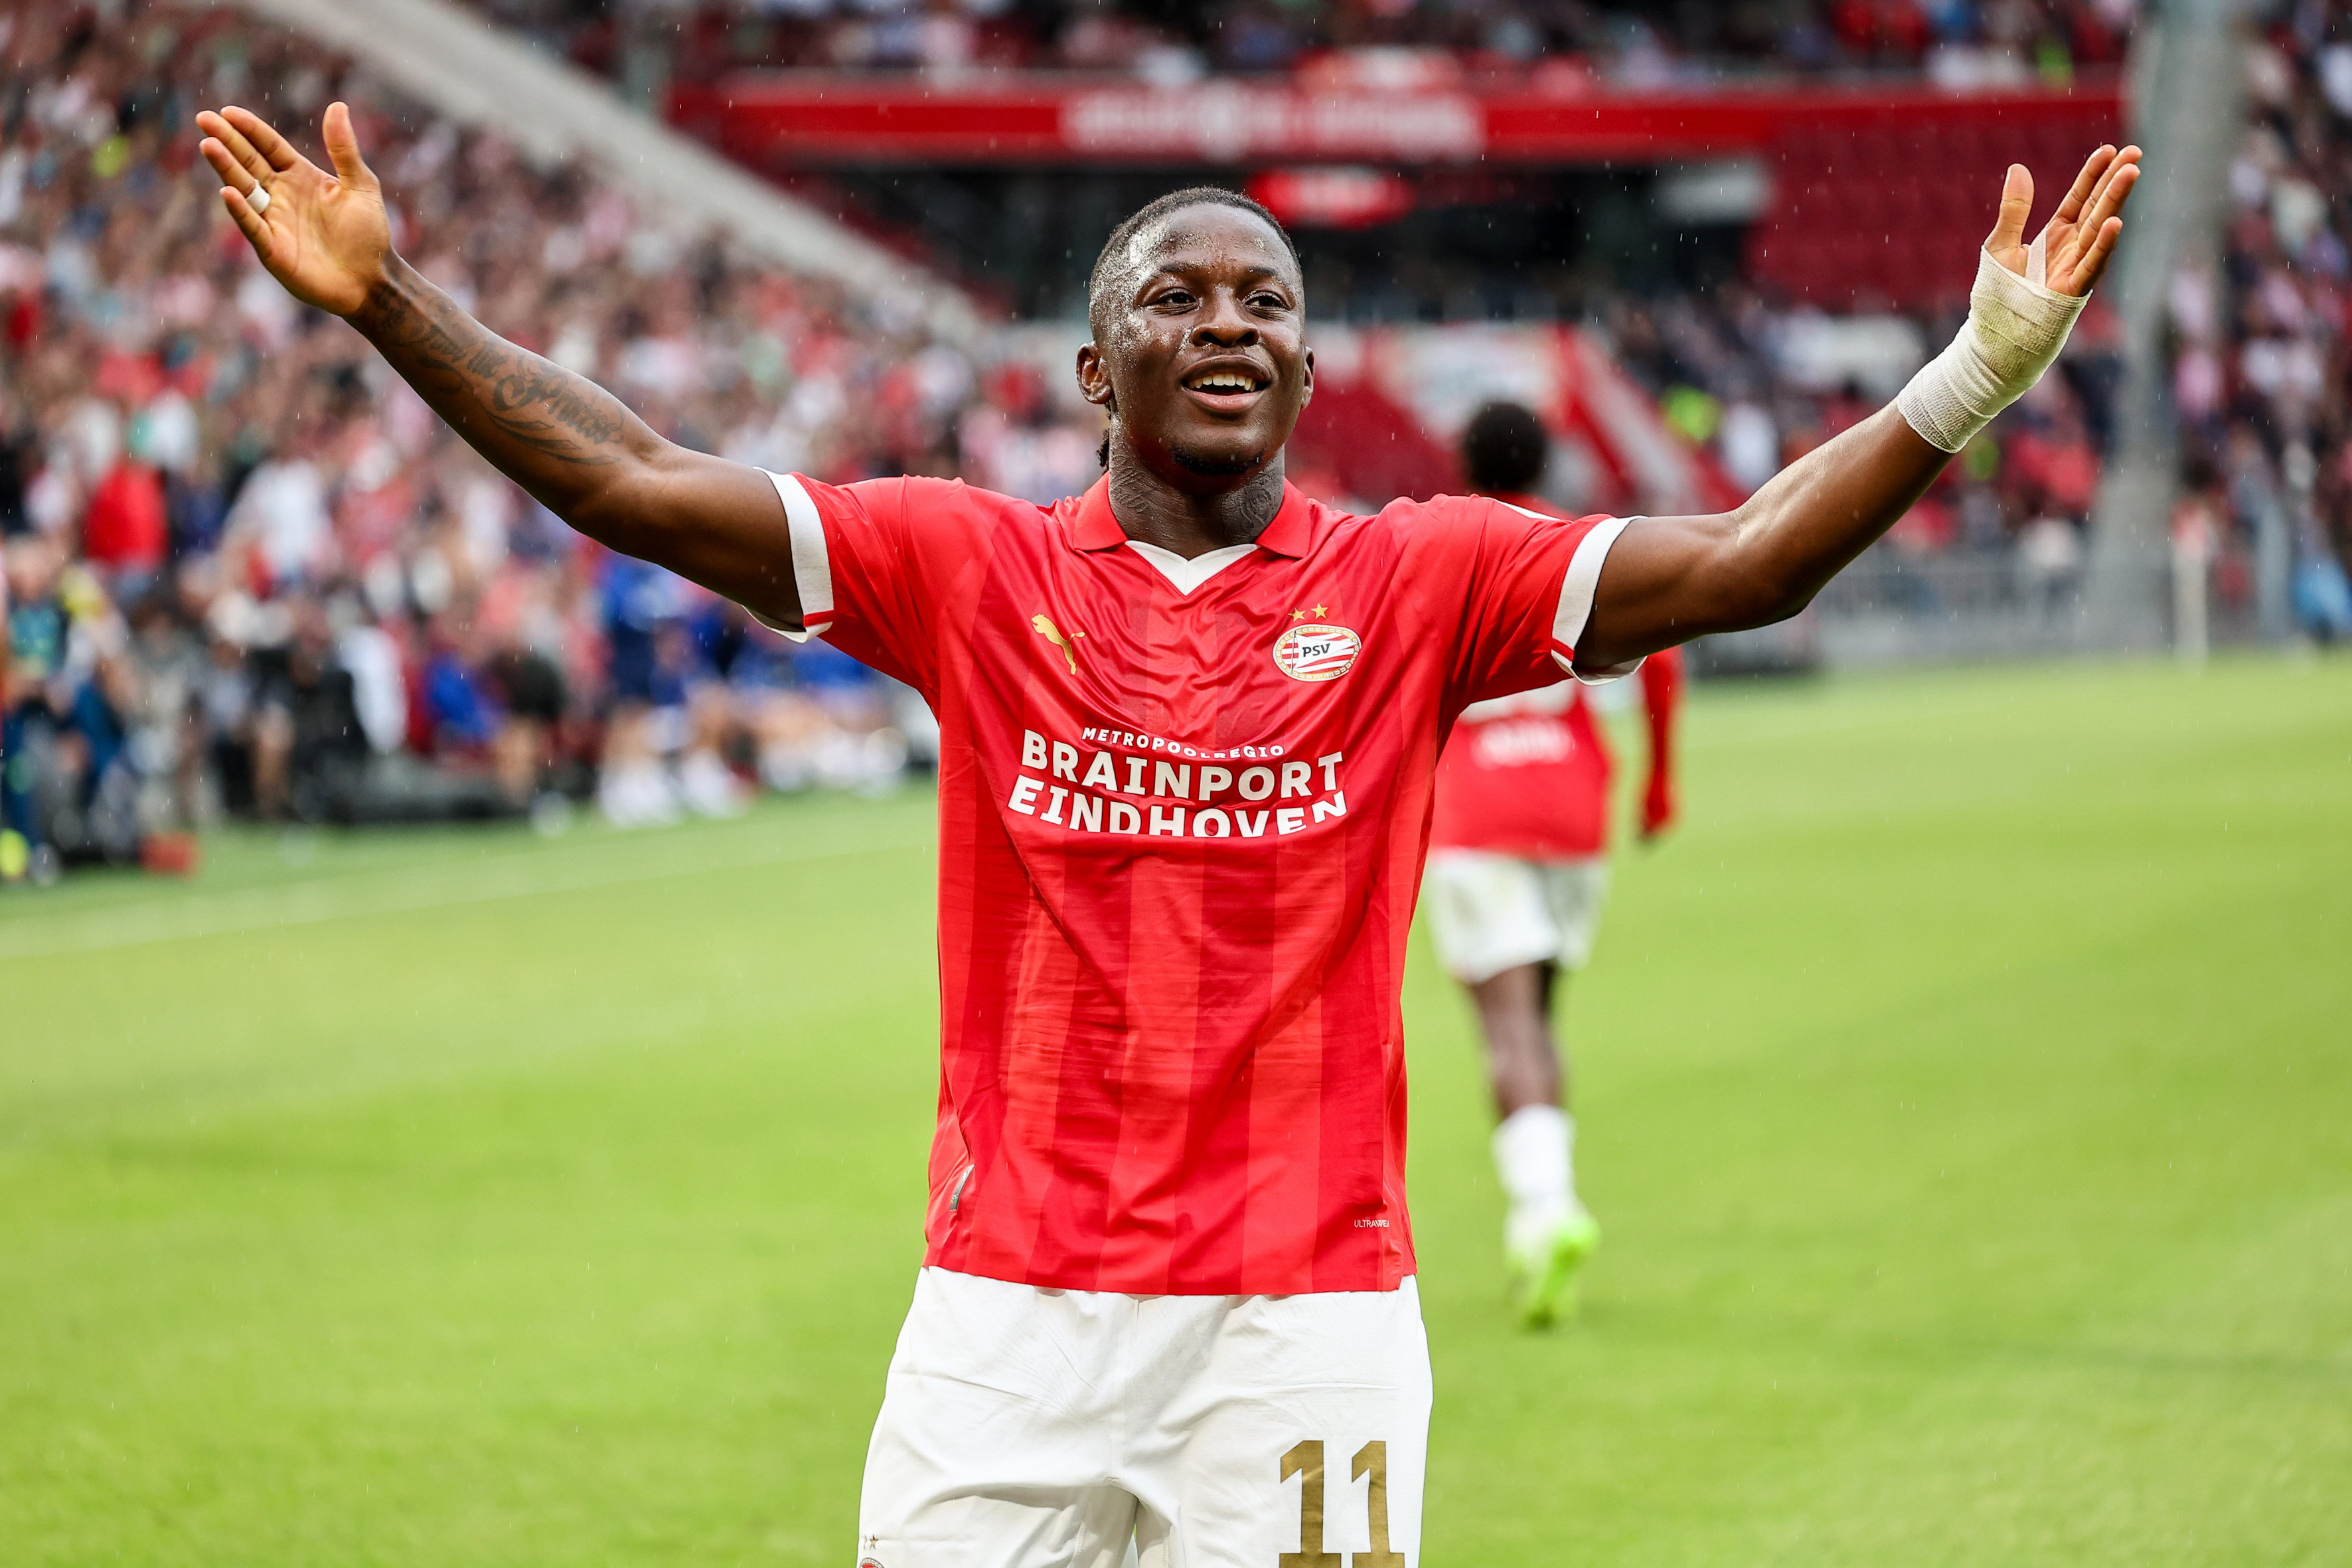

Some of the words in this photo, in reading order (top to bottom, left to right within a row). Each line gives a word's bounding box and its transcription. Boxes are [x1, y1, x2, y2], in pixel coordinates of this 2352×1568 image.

[1302, 643, 1330, 657] PSV
[1021, 729, 1343, 801] BRAINPORT
[1082, 728, 1285, 759] METROPOOLREGIO
[1007, 774, 1348, 838] EINDHOVEN
[1279, 1440, 1405, 1568] 11
